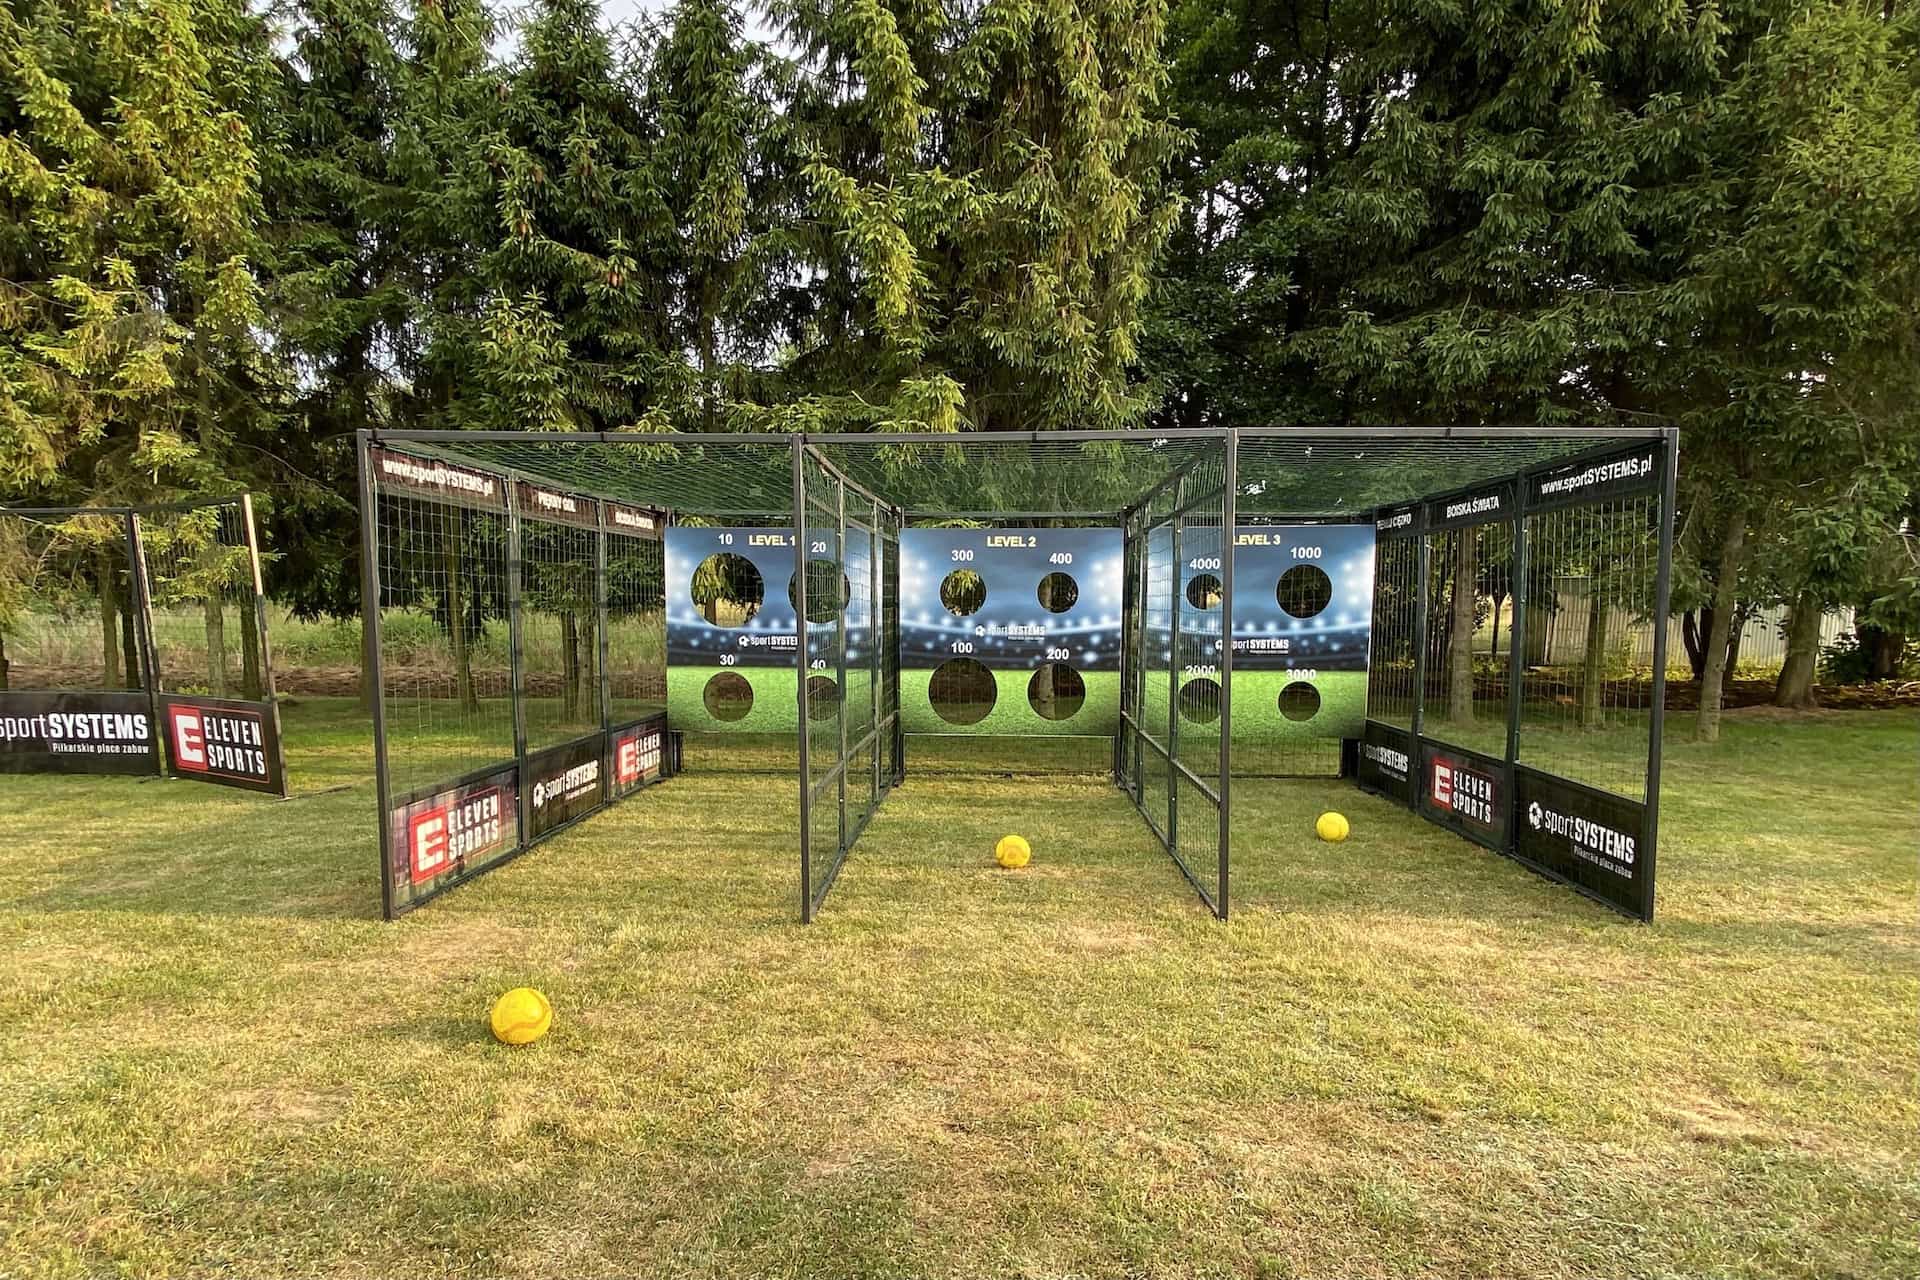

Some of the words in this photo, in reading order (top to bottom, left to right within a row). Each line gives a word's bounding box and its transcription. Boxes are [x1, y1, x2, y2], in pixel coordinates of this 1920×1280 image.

[382, 459, 494, 497] www.sportSYSTEMS.pl
[1540, 455, 1653, 494] www.sportSYSTEMS.pl
[1446, 503, 1472, 518] BOISKA
[1471, 495, 1500, 514] ŚWIATA
[718, 533, 733, 545] 10
[749, 535, 787, 546] LEVEL
[789, 535, 796, 546] 1
[987, 536, 1026, 547] LEVEL
[1027, 536, 1037, 547] 2
[1232, 535, 1272, 546] LEVEL
[1272, 534, 1281, 546] 3
[811, 541, 827, 553] 20
[1290, 547, 1322, 559] 1000
[951, 550, 974, 561] 300
[1049, 552, 1073, 565] 400
[1189, 558, 1220, 570] 4000
[951, 642, 973, 654] 100
[1231, 639, 1289, 650] portSYSTEMS
[719, 654, 735, 666] 30
[1046, 648, 1069, 660] 200
[811, 659, 826, 671] 40
[1185, 665, 1216, 677] 2000
[1286, 669, 1317, 681] 3000
[0, 712, 149, 741] sportSYSTEMS
[204, 715, 262, 747] ELEVEN
[97, 744, 121, 755] place
[635, 733, 660, 755] ELEVEN
[207, 744, 266, 776] SPORTS
[545, 760, 598, 801] sportSYSTEMS
[1453, 769, 1492, 802] ELEVEN
[1452, 791, 1492, 824] SPORTS
[447, 794, 499, 834] ELEVEN
[447, 819, 499, 862] SPORTS
[1544, 809, 1635, 865] sportSYSTEMS
